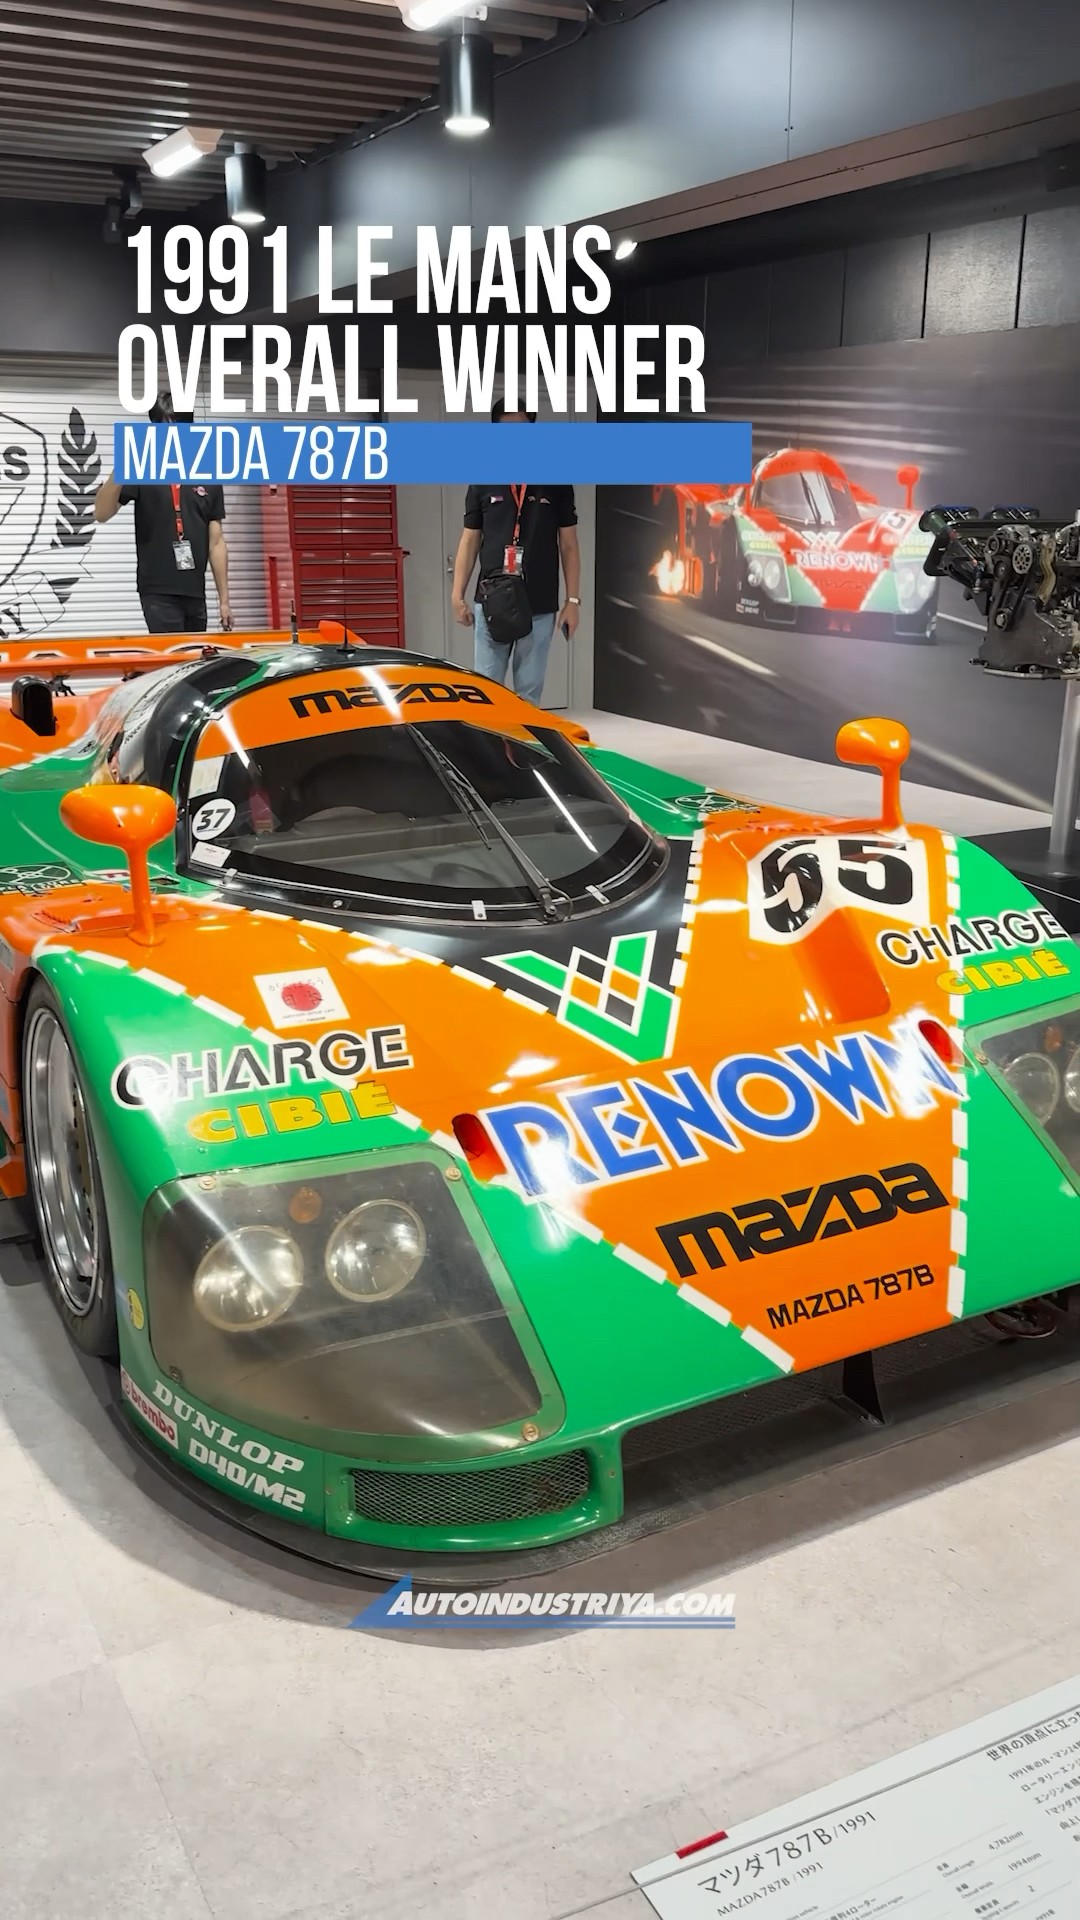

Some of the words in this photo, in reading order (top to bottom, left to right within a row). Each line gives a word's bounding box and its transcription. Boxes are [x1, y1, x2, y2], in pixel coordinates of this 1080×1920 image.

[196, 807, 232, 832] 37
[760, 838, 914, 933] 55
[880, 910, 1069, 966] CHARGE
[115, 1027, 411, 1106] CHARGE
[485, 1027, 965, 1198] RENOWN
[766, 1283, 865, 1330] MAZDA
[863, 1263, 935, 1301] 787B
[130, 1382, 176, 1441] brembo
[152, 1379, 305, 1475] DUNLOP
[188, 1437, 306, 1513] D40/M2
